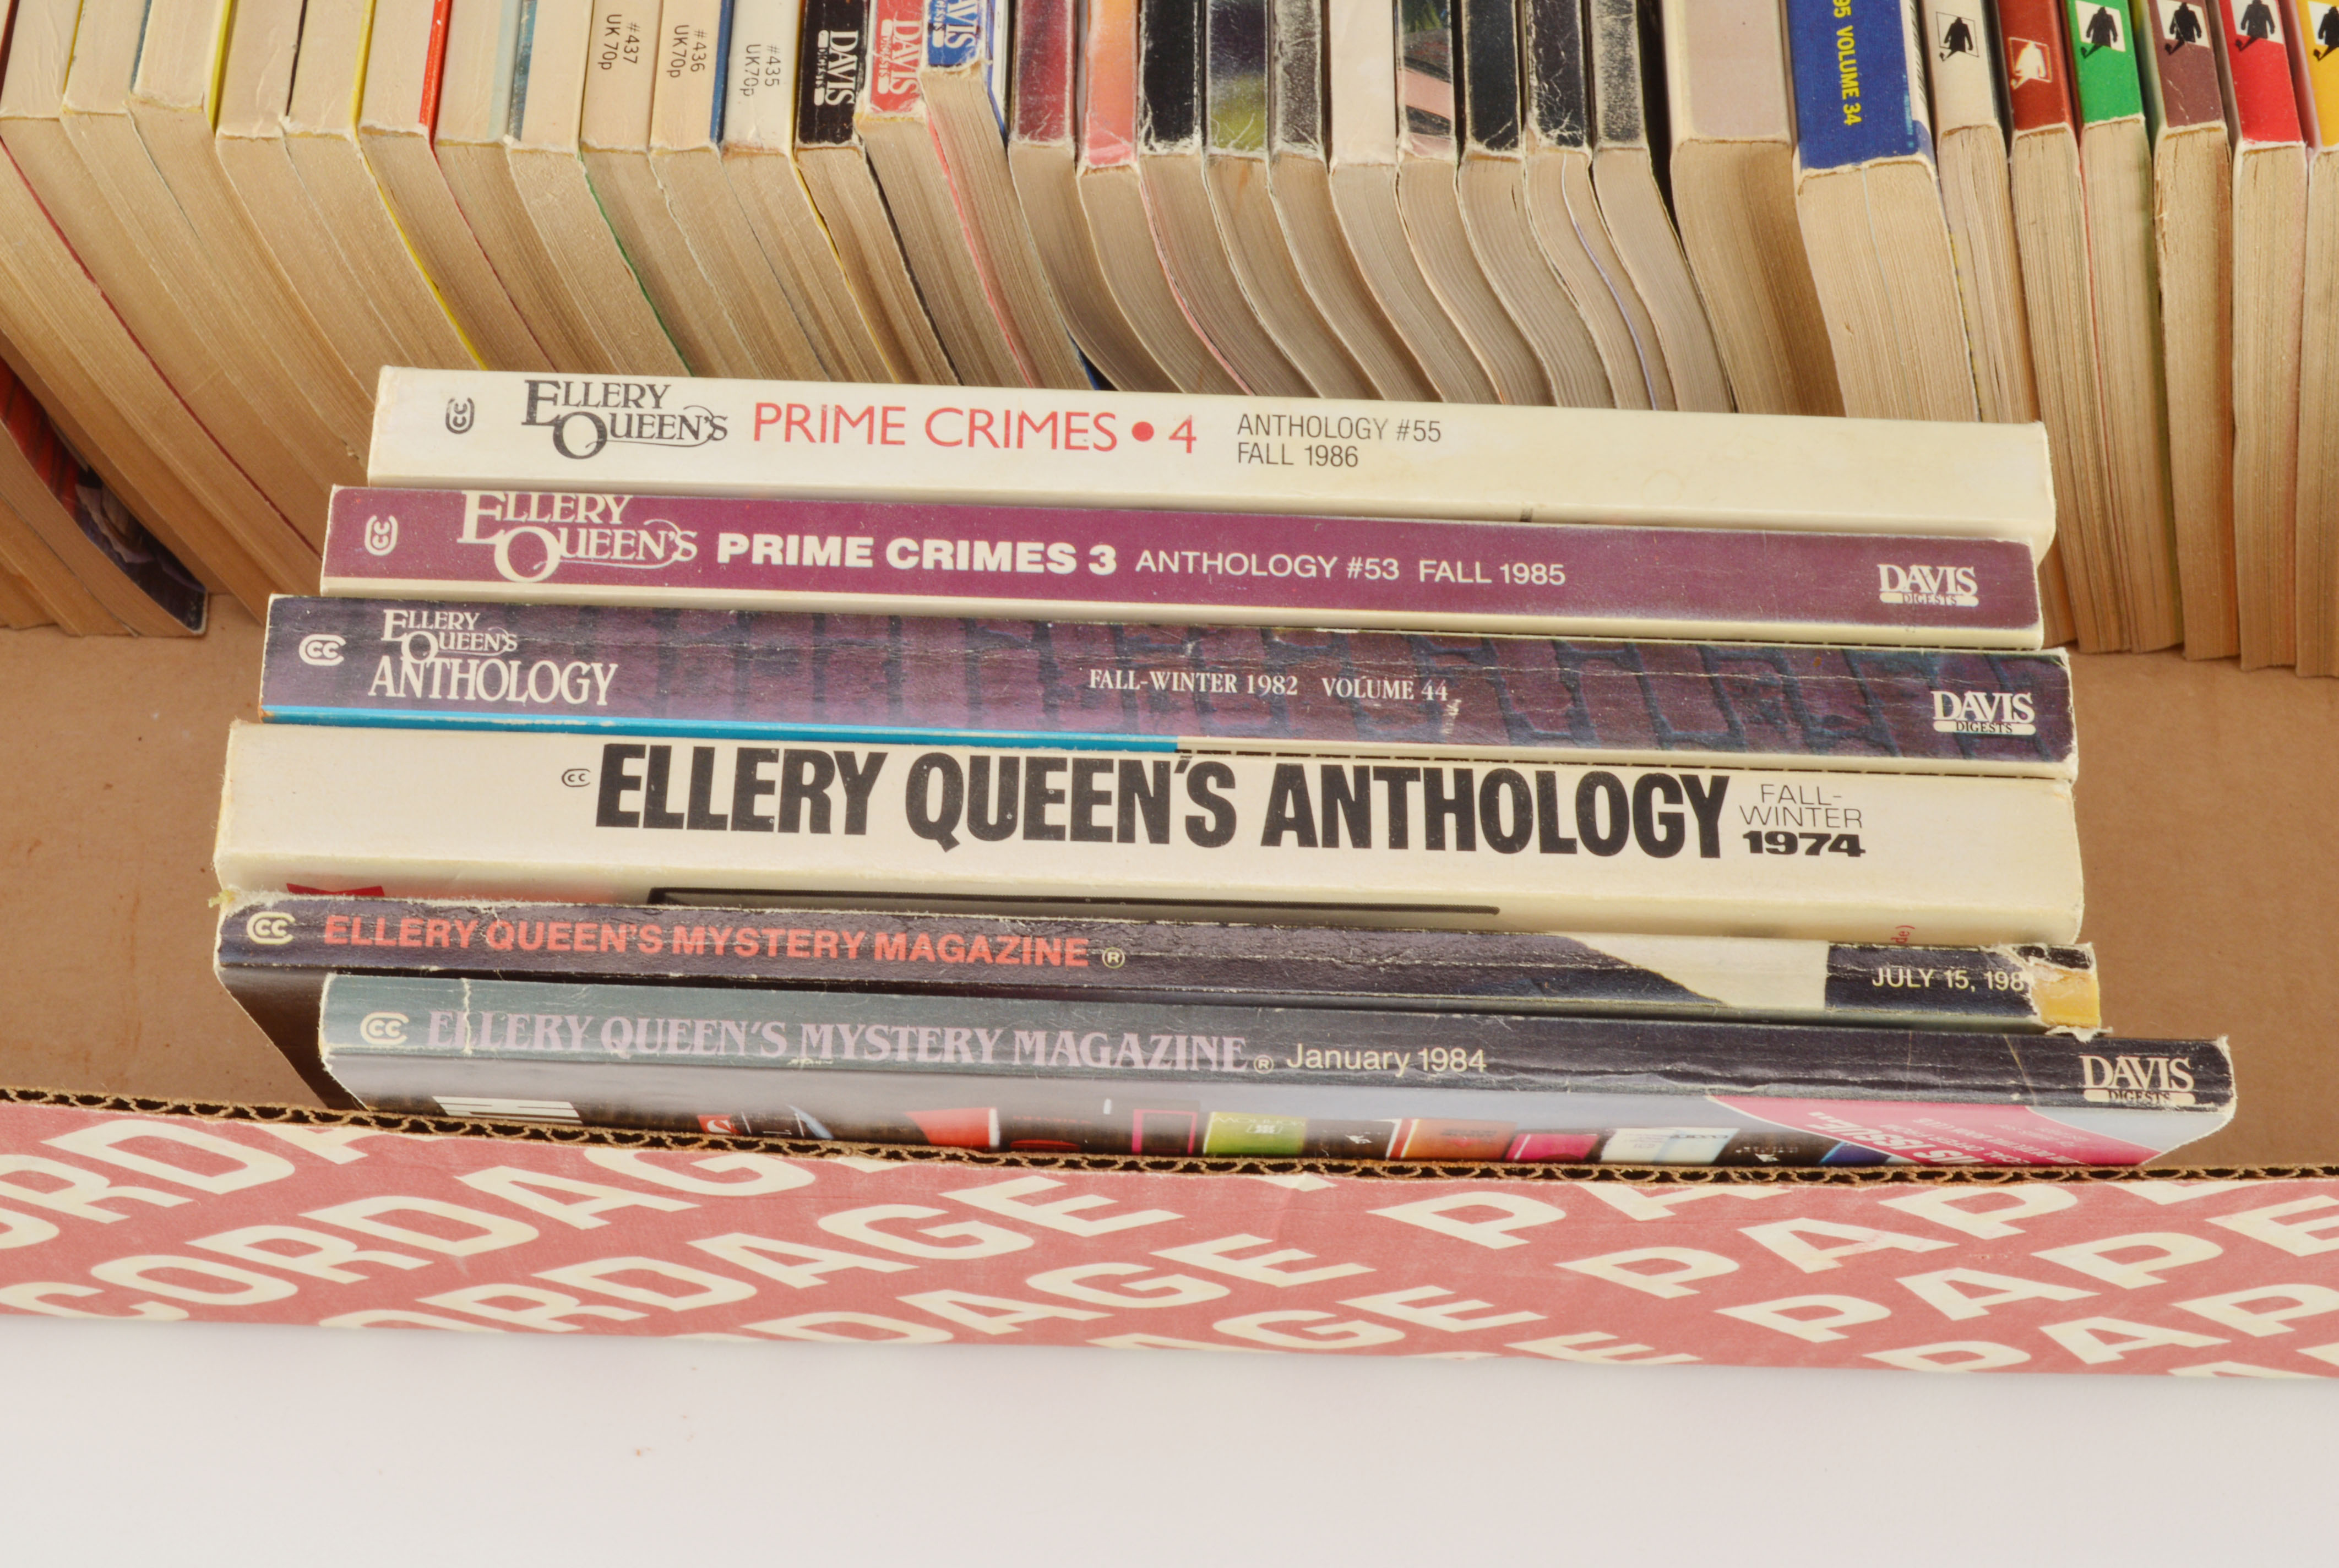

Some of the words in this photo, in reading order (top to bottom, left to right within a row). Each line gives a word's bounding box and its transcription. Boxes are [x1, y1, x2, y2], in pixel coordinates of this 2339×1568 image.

[623, 21, 640, 64] #437
[690, 28, 708, 72] #436
[889, 20, 922, 94] DAVIS
[1836, 25, 1860, 100] VOLUME
[764, 43, 781, 87] #435
[825, 30, 859, 105] DAVIS
[1843, 102, 1863, 126] 34
[521, 379, 671, 427] ELLERY
[553, 405, 728, 460] QUEEN'S
[753, 402, 906, 445] PRIME
[924, 406, 1118, 452] CRIMES
[1168, 415, 1197, 454] 4
[1237, 414, 1389, 440] ANTHOLOGY
[1396, 419, 1442, 442] #55
[1237, 442, 1294, 466] FALL
[1304, 445, 1358, 467] 1986
[456, 491, 633, 545] ELLERY
[494, 519, 698, 583] QUEEN'S
[717, 532, 874, 567] PRIME
[885, 537, 1077, 574] CRIMES
[1088, 545, 1117, 575] 3
[1135, 550, 1338, 578] ANTHOLOGY
[1347, 557, 1400, 580] #53
[1419, 560, 1492, 584] FALL
[1500, 563, 1566, 585] 1985
[1877, 564, 1978, 596] DAVIS
[381, 609, 480, 641] ELLERY
[401, 627, 518, 663] QUEEN'S
[368, 656, 618, 705] ANTHOLOGY
[1089, 669, 1238, 694] FALL-WINTER
[1247, 674, 1298, 695] 1982
[1322, 677, 1414, 700] VOLUME
[1421, 680, 1448, 701] 44
[1930, 691, 2035, 724] DAVIS
[1956, 721, 2013, 733] DIGESTS
[595, 743, 888, 835] ELLERY
[905, 752, 1238, 852] QUEEN'S
[1260, 763, 1729, 859] ANTHOLOGY
[1761, 784, 1841, 805] FALL-
[1739, 805, 1862, 829] WINTER
[1743, 830, 1865, 857] 1974
[325, 915, 478, 949] ELLERY
[486, 921, 663, 954] QUEEN'S
[672, 925, 866, 961] MYSTERY
[874, 930, 1089, 967] MAGAZINE
[1873, 967, 1935, 988] JULY
[1944, 970, 1976, 992] 15,
[1983, 971, 2025, 992] 198
[428, 1010, 595, 1052] ELLERY
[601, 1016, 787, 1059] QUEEN'S
[801, 1023, 1004, 1064] MYSTERY
[1014, 1031, 1247, 1072] MAGAZINE
[1287, 1043, 1411, 1077] January
[1417, 1047, 1487, 1072] 1984
[2079, 1054, 2194, 1092] DAVIS
